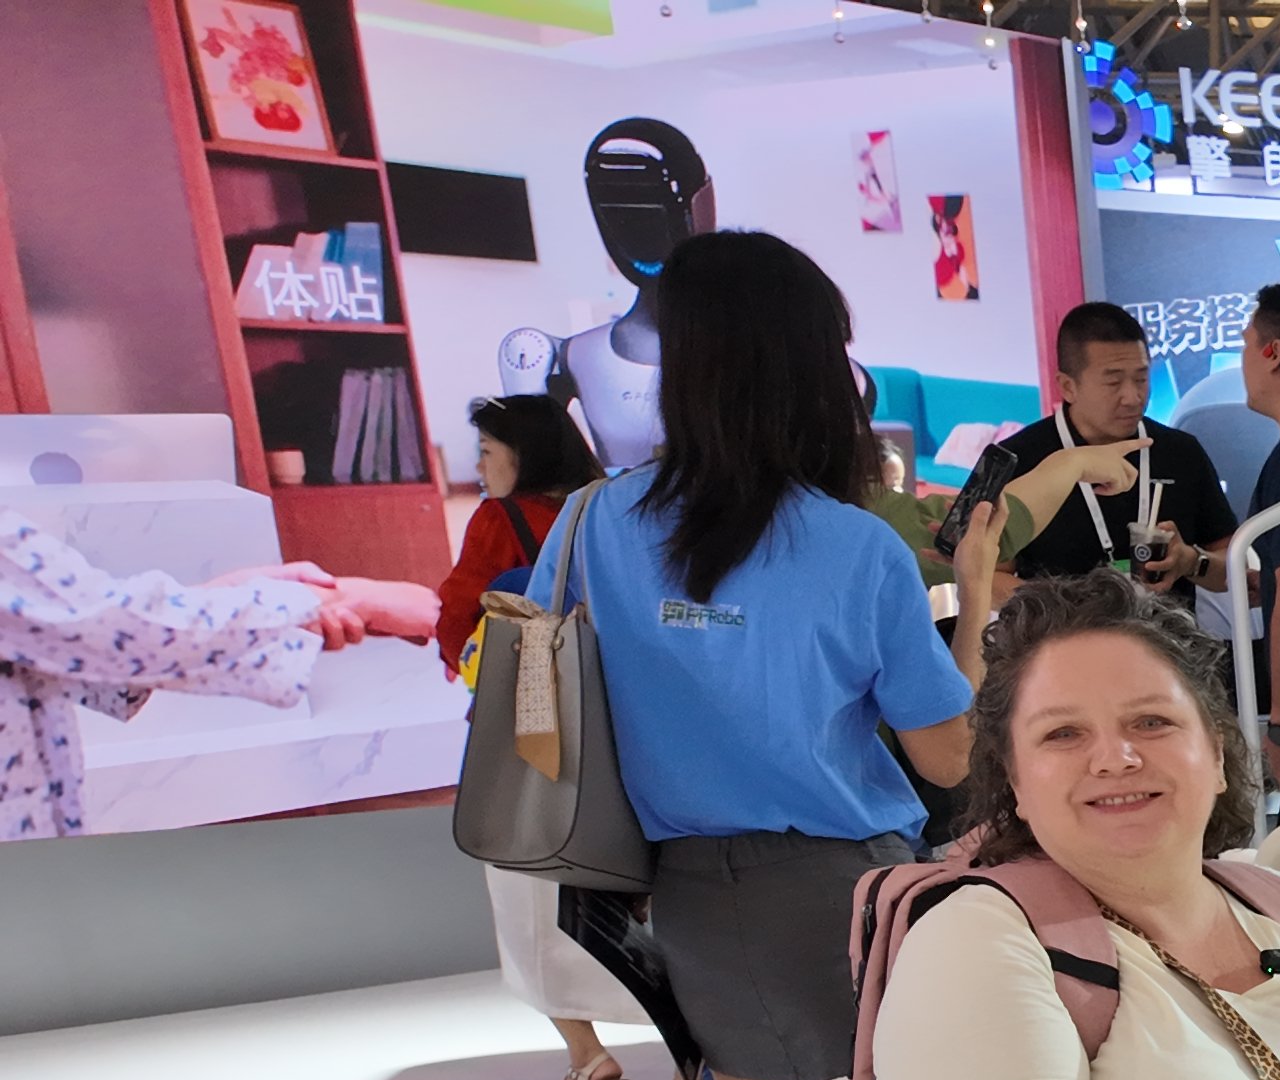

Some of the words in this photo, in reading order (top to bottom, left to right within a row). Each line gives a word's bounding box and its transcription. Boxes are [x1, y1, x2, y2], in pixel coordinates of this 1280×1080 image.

[254, 259, 383, 321] 体贴
[1122, 292, 1258, 357] 服务搭
